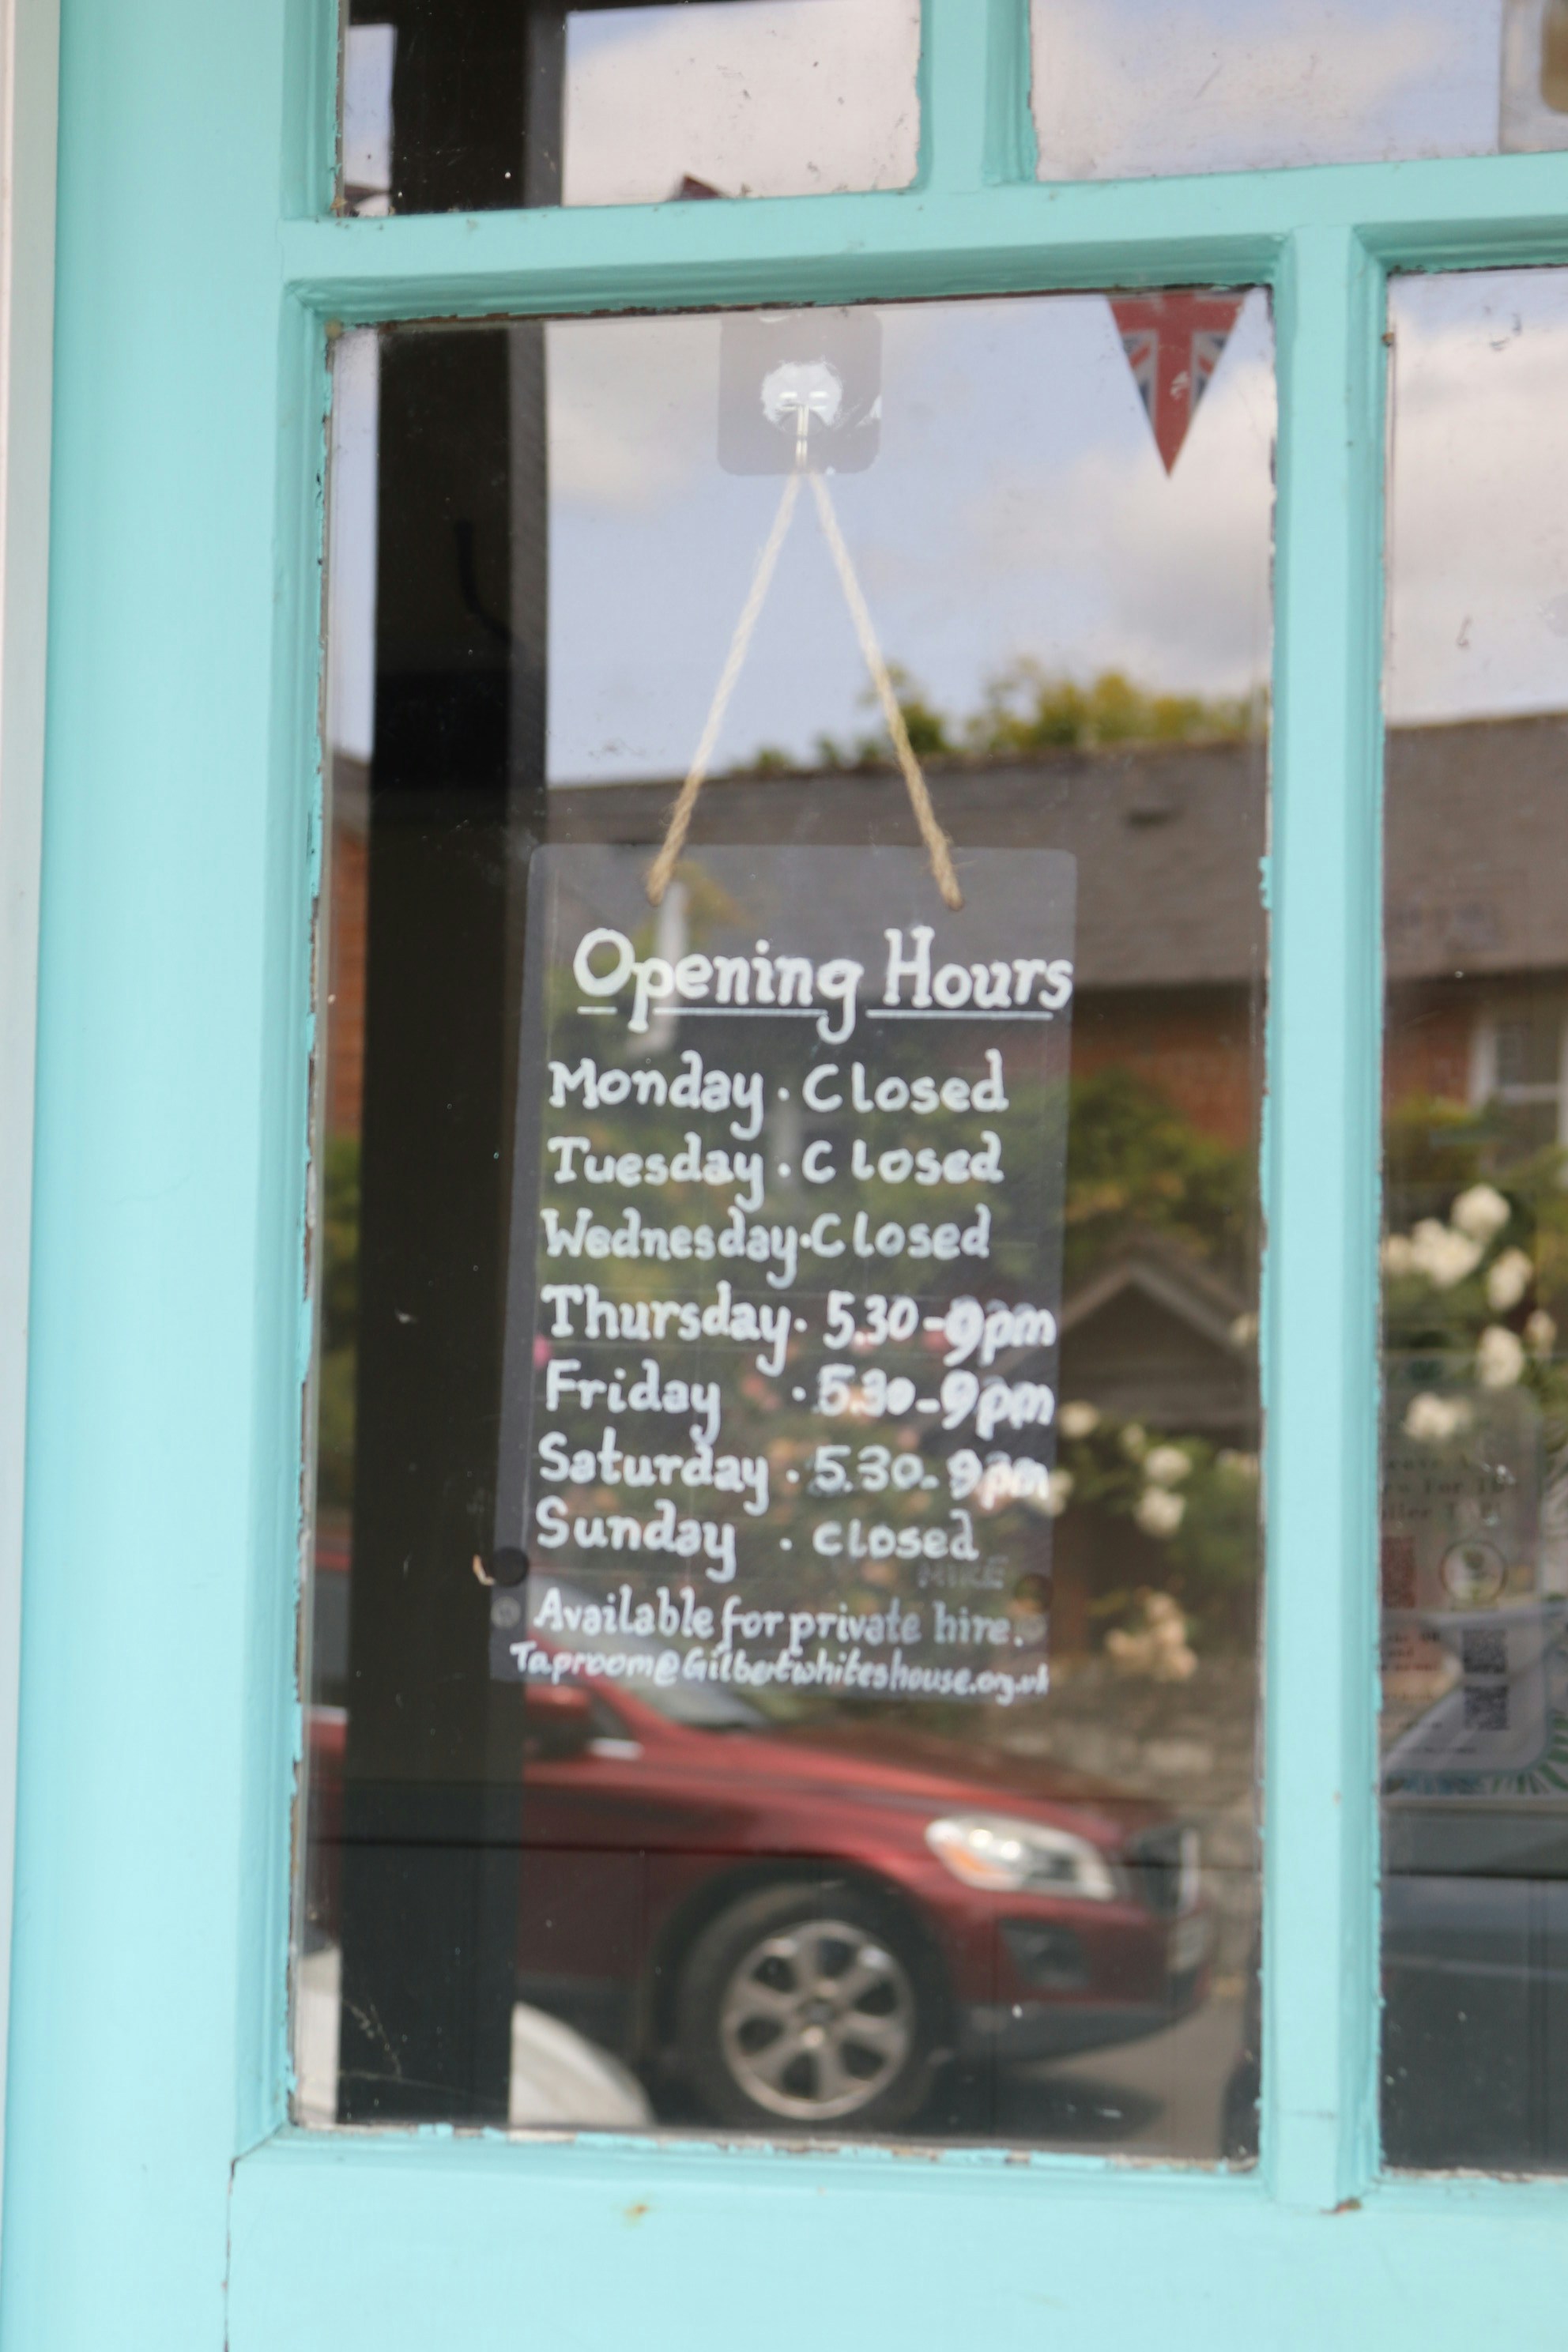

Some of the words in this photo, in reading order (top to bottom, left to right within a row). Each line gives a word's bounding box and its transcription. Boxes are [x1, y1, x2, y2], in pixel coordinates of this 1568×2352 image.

[573, 927, 864, 1045] Opening
[884, 925, 1074, 1009] Hours
[802, 1048, 1010, 1114] Closed
[802, 1130, 1004, 1185] Closed
[546, 1358, 722, 1446] Friday
[536, 1495, 736, 1583] Sunday
[533, 1585, 714, 1639] Available
[719, 1596, 784, 1655] for
[790, 1596, 923, 1657] private
